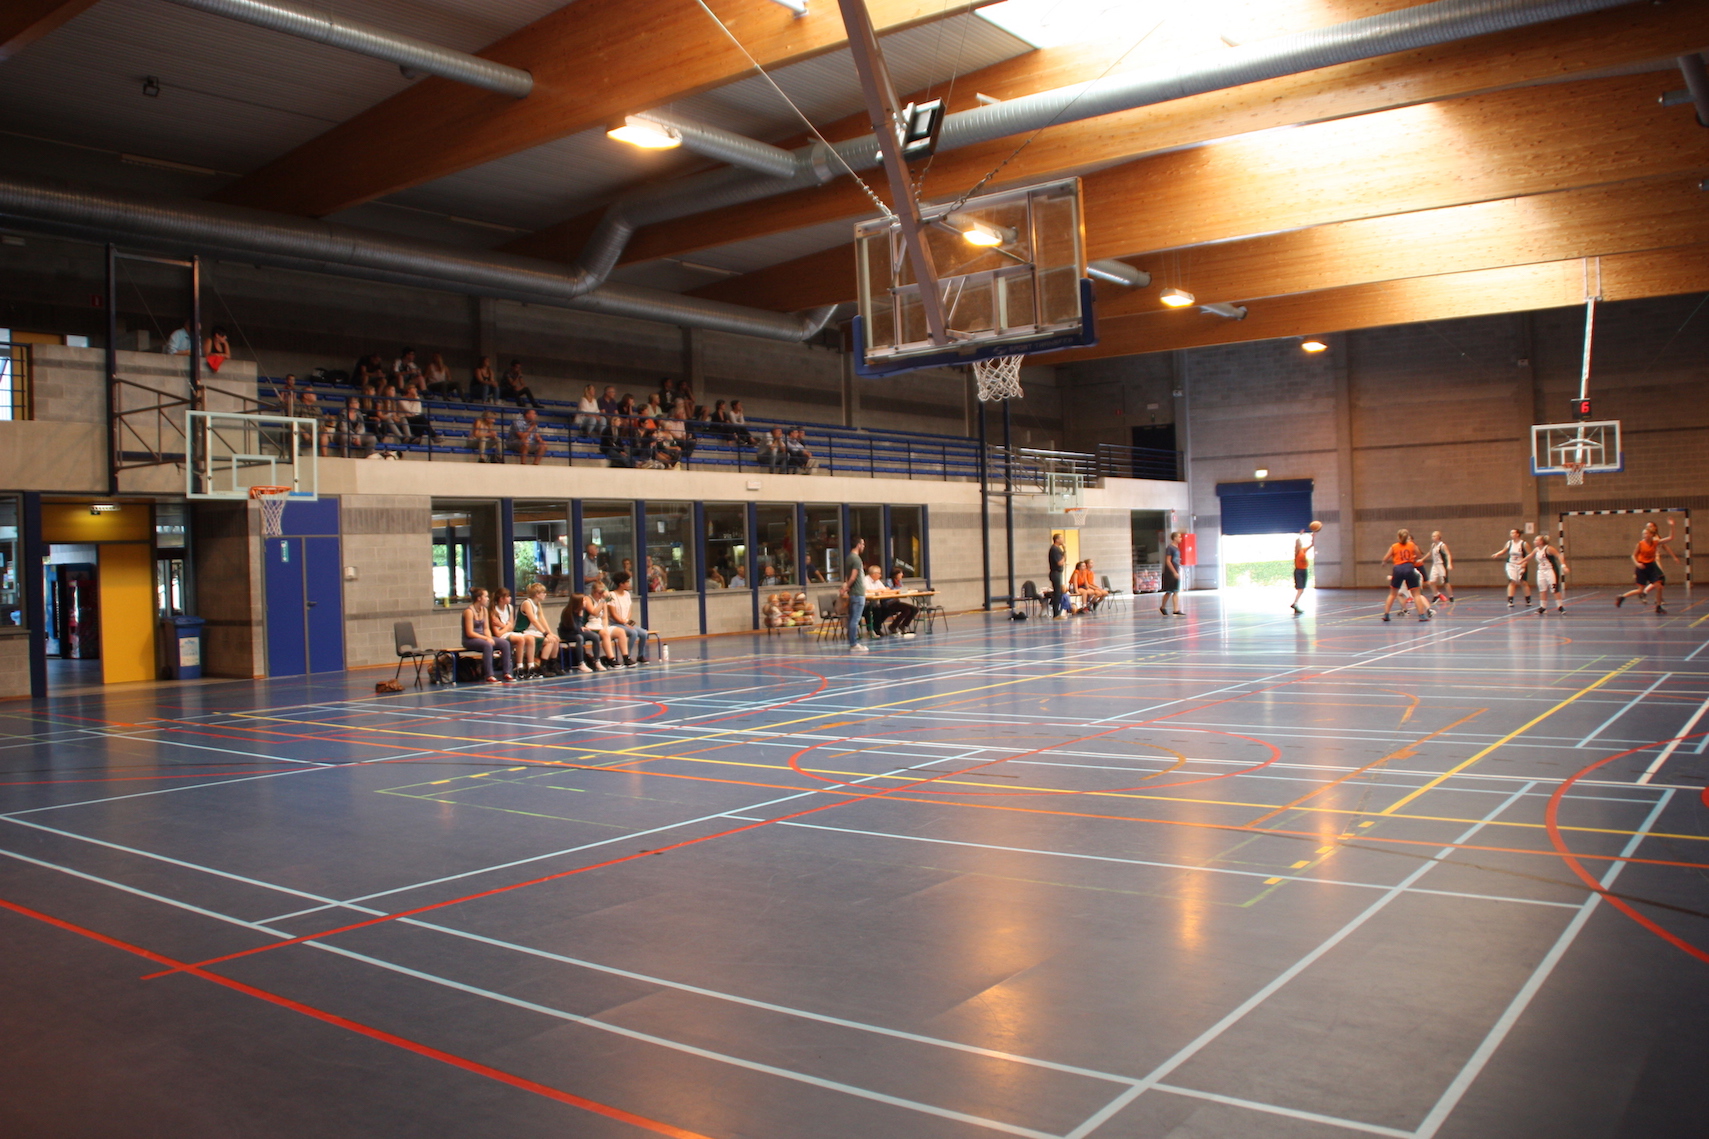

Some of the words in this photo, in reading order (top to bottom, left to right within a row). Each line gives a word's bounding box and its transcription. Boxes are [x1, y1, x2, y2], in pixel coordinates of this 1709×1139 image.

[1008, 344, 1032, 352] SPORT
[1580, 401, 1591, 414] 6
[1400, 549, 1411, 561] 10
